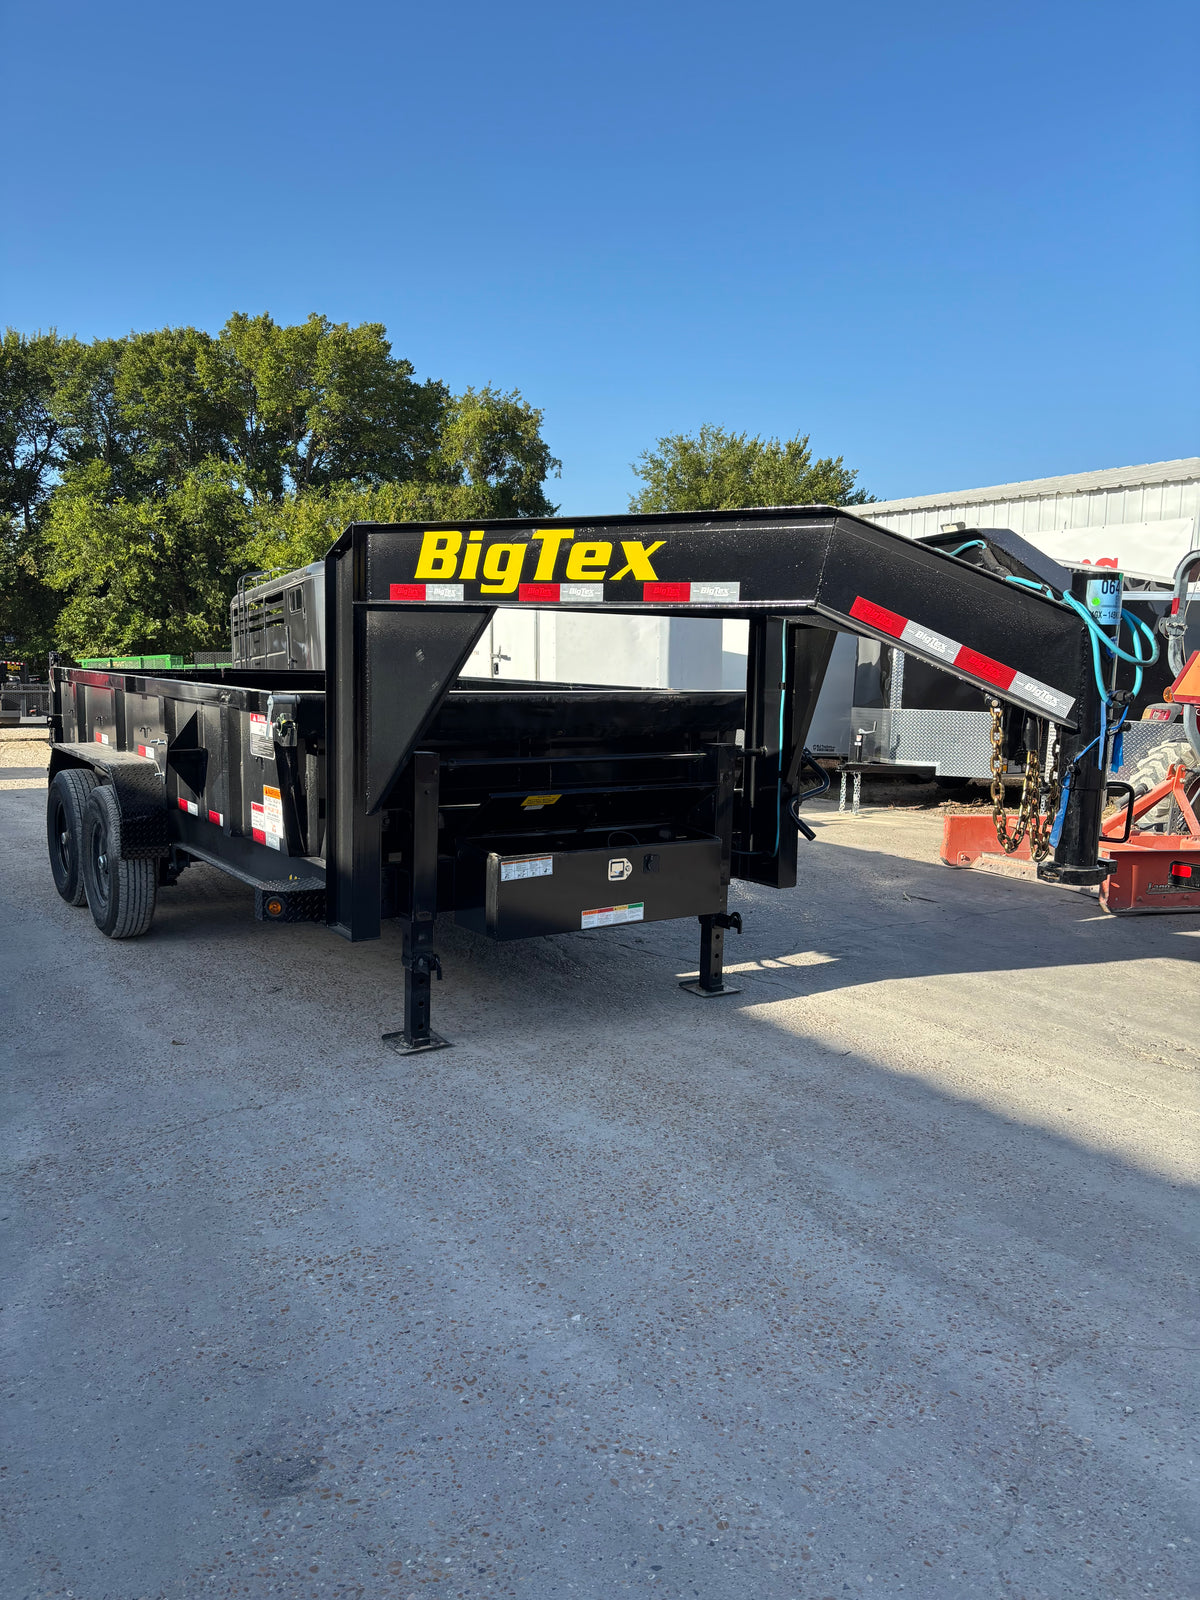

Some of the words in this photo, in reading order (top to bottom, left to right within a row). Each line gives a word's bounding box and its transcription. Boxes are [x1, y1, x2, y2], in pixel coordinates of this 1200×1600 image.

[414, 528, 667, 595] BigTex
[568, 587, 595, 597] BigTex
[700, 586, 730, 597] BigTex
[915, 631, 948, 653] BigTex
[1024, 682, 1060, 707] BigTex
